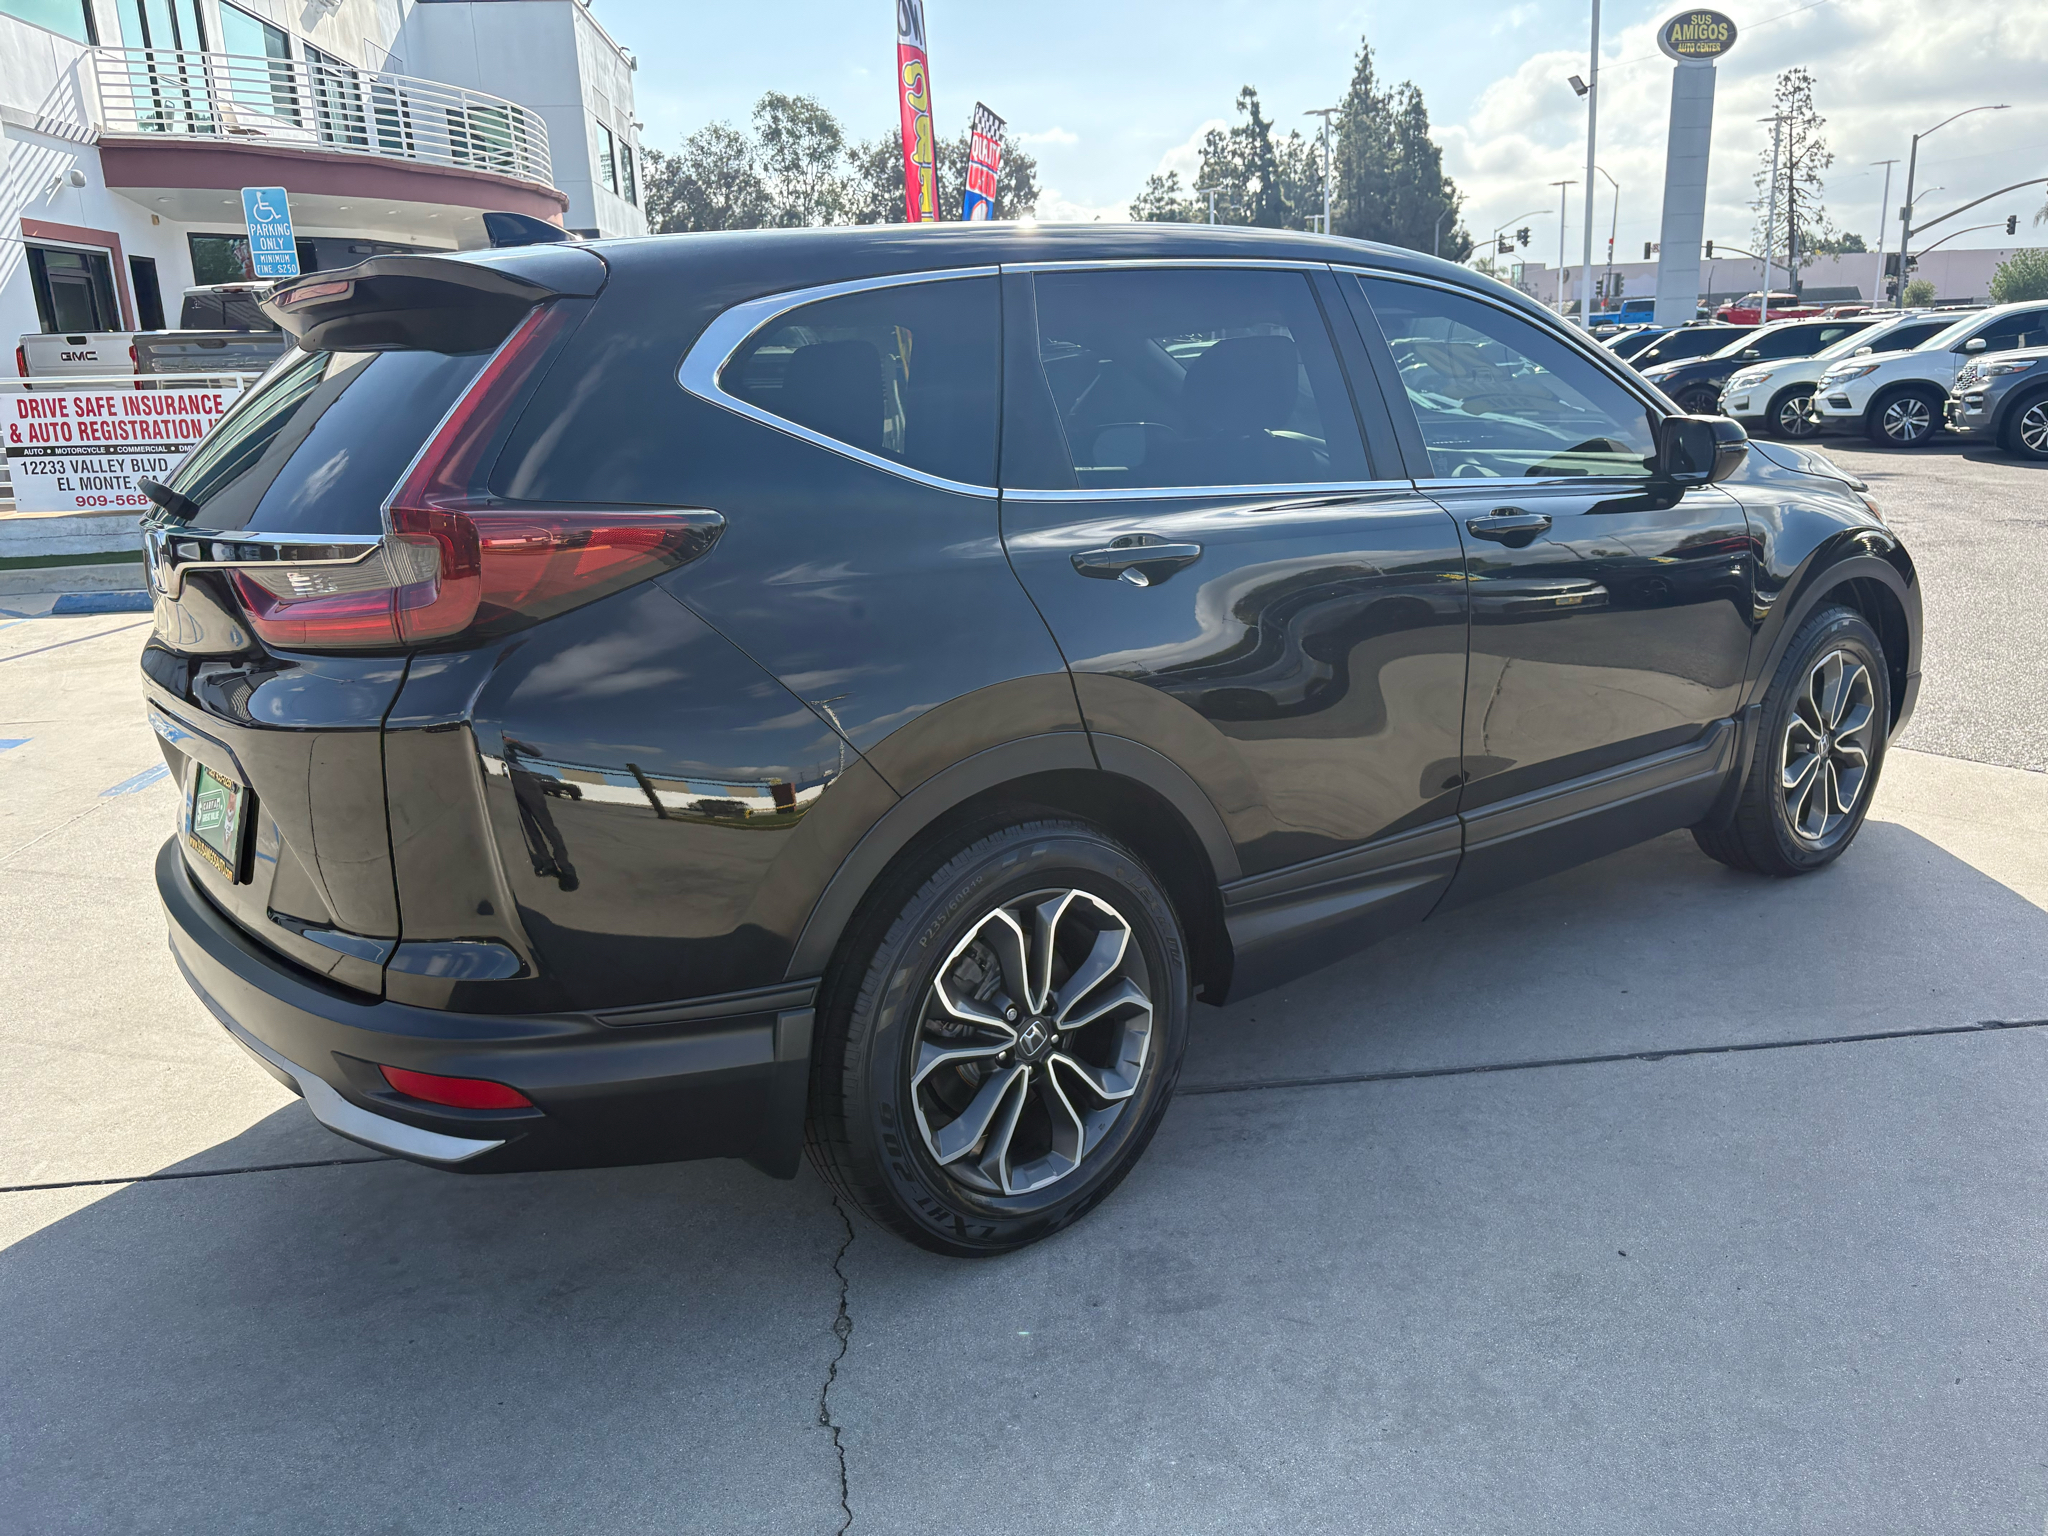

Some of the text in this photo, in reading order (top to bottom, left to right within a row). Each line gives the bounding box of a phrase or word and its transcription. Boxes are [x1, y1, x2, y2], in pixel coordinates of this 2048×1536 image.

[1691, 14, 1712, 25] SUS
[1670, 22, 1728, 42] AMIGOS
[1677, 42, 1721, 53] AUTO CENTER
[250, 223, 290, 236] PARKING
[260, 237, 284, 250] ONLY
[260, 254, 290, 263] MINIMUM
[257, 264, 297, 274] FINE $250
[60, 351, 98, 361] GMC
[16, 394, 224, 419] DRIVE SAFE INSURANCE
[9, 423, 23, 444] &
[28, 421, 73, 443] AUTO
[77, 418, 203, 441] REGISTRATION
[23, 448, 44, 456] AUTO
[55, 446, 106, 455] MOTORCYCLE
[117, 445, 168, 454] COMMERCIAL
[20, 457, 173, 475] 12233 VALLEY BLVD.
[56, 476, 76, 492] EL
[78, 475, 137, 492] MONTE,
